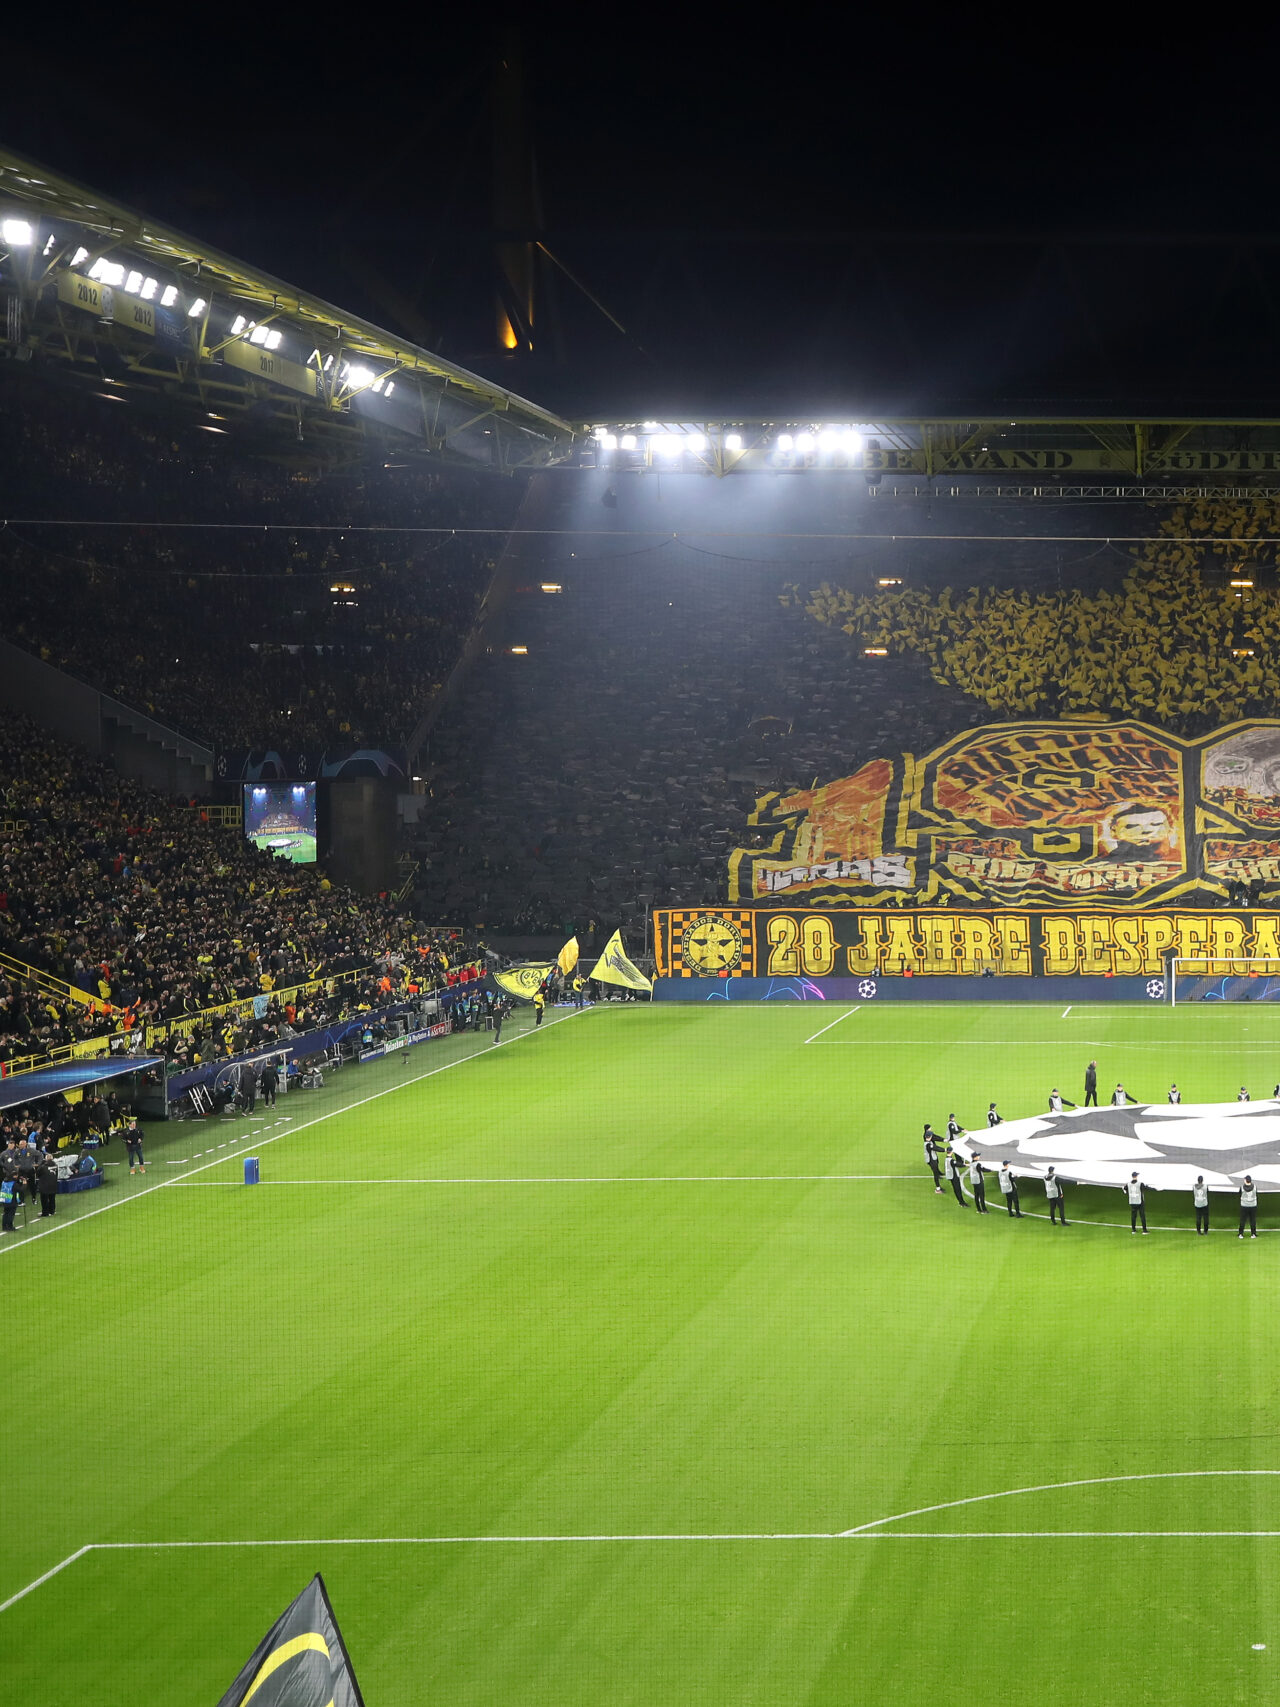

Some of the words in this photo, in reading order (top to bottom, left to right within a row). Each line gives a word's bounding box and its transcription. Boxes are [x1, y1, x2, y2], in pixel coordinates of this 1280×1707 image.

[77, 282, 98, 307] 2012
[133, 304, 153, 328] 2012
[259, 354, 274, 375] 2017
[939, 450, 1073, 469] WAND
[767, 916, 842, 977] 20
[848, 915, 1032, 977] JAHRE
[385, 1039, 405, 1053] Heineken
